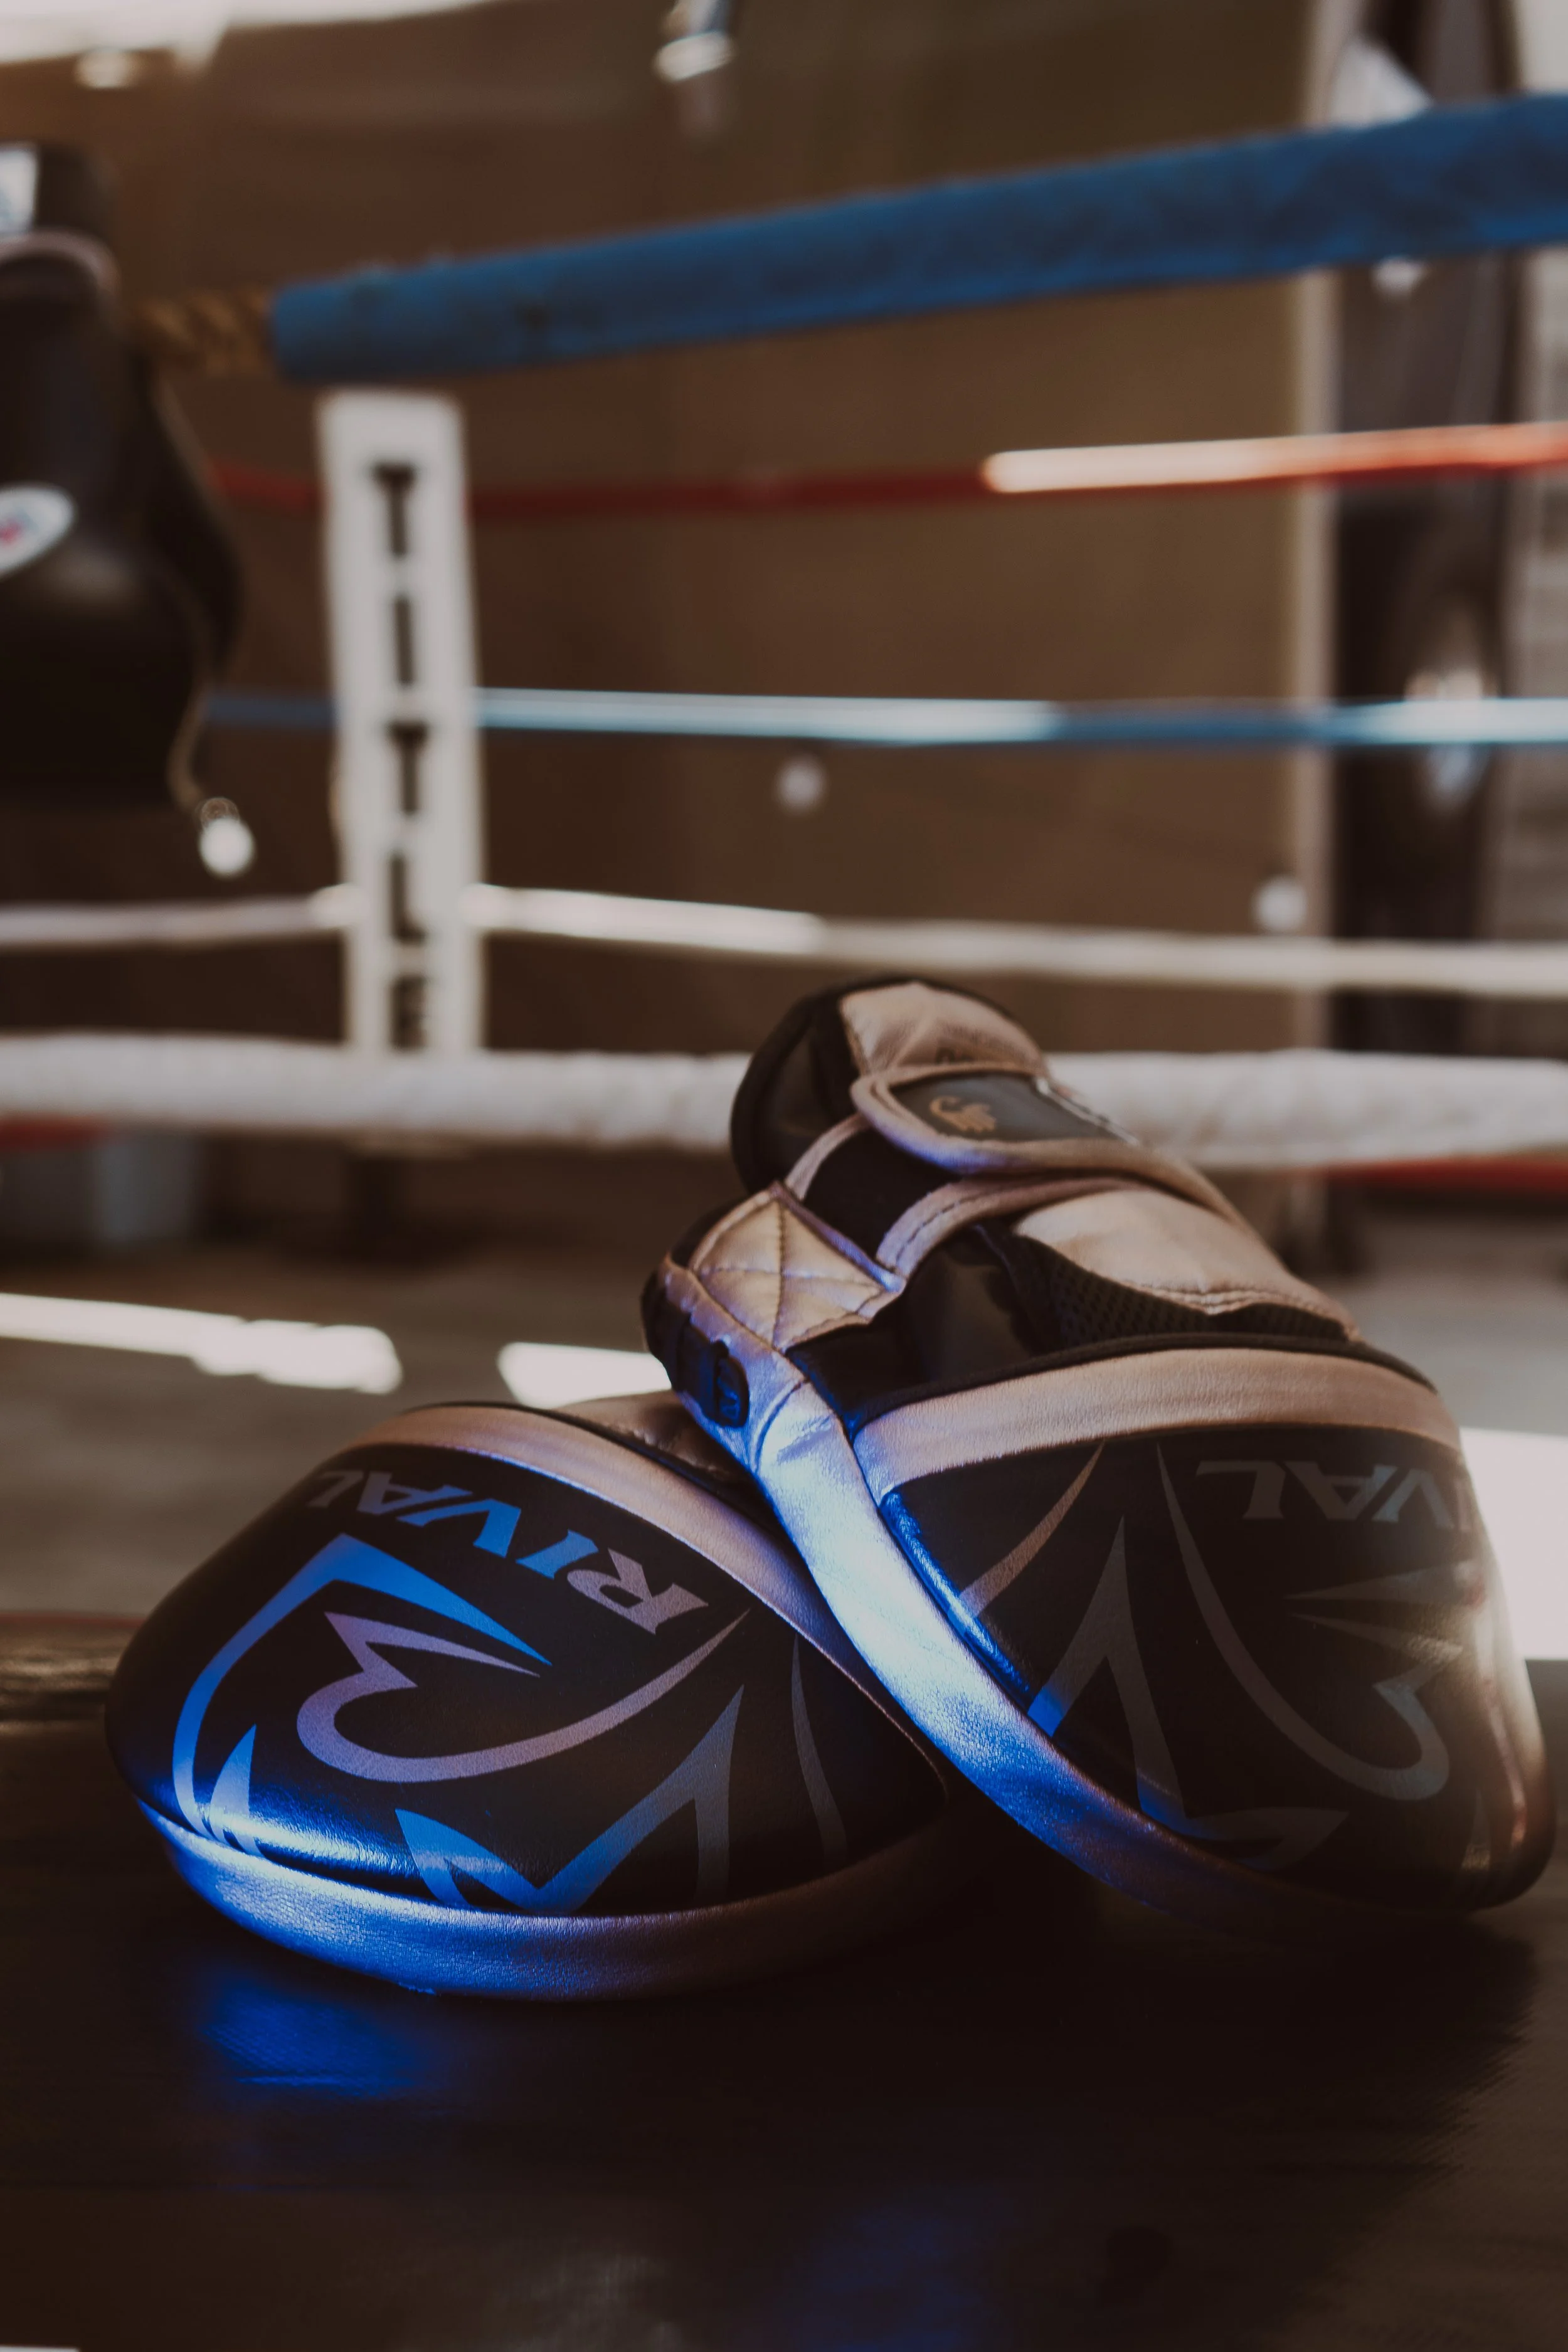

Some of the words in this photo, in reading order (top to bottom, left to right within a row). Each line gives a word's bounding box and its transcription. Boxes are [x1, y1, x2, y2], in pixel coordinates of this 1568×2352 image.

[371, 464, 430, 1050] TITLE
[306, 1470, 709, 1635] RIVAL
[1195, 1459, 1473, 1532] IVAL
